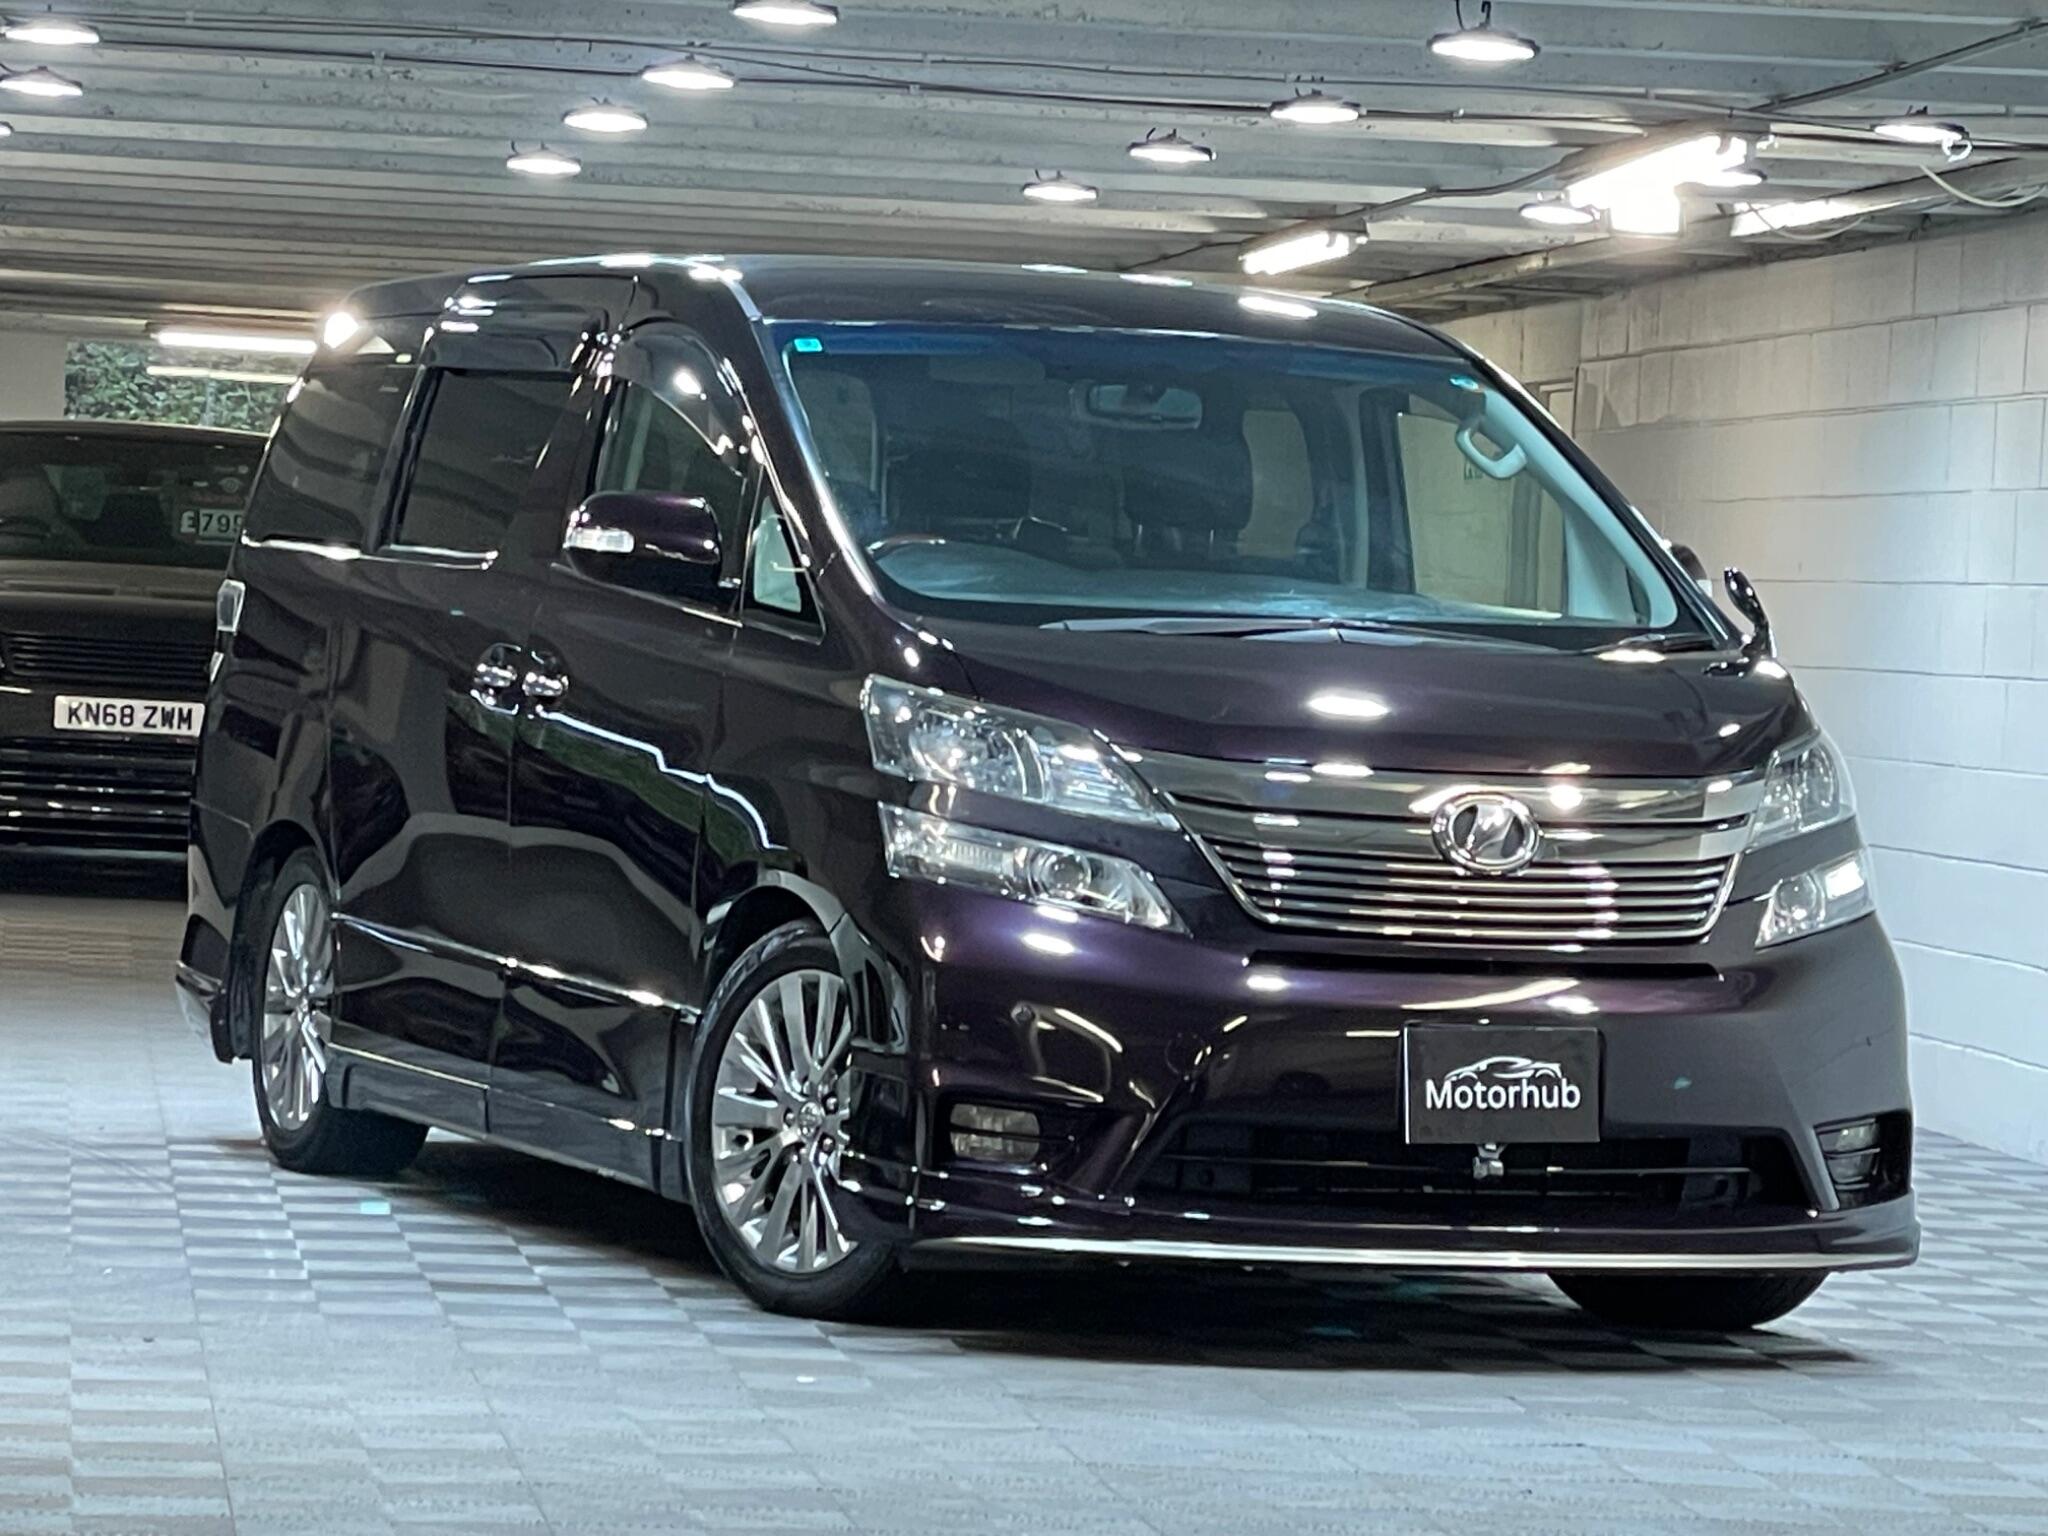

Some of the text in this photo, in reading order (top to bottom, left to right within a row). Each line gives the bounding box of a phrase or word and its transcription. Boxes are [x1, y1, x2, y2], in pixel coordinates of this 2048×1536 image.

[67, 702, 193, 730] KN68 ZWM
[1426, 1078, 1581, 1110] Motorhub
